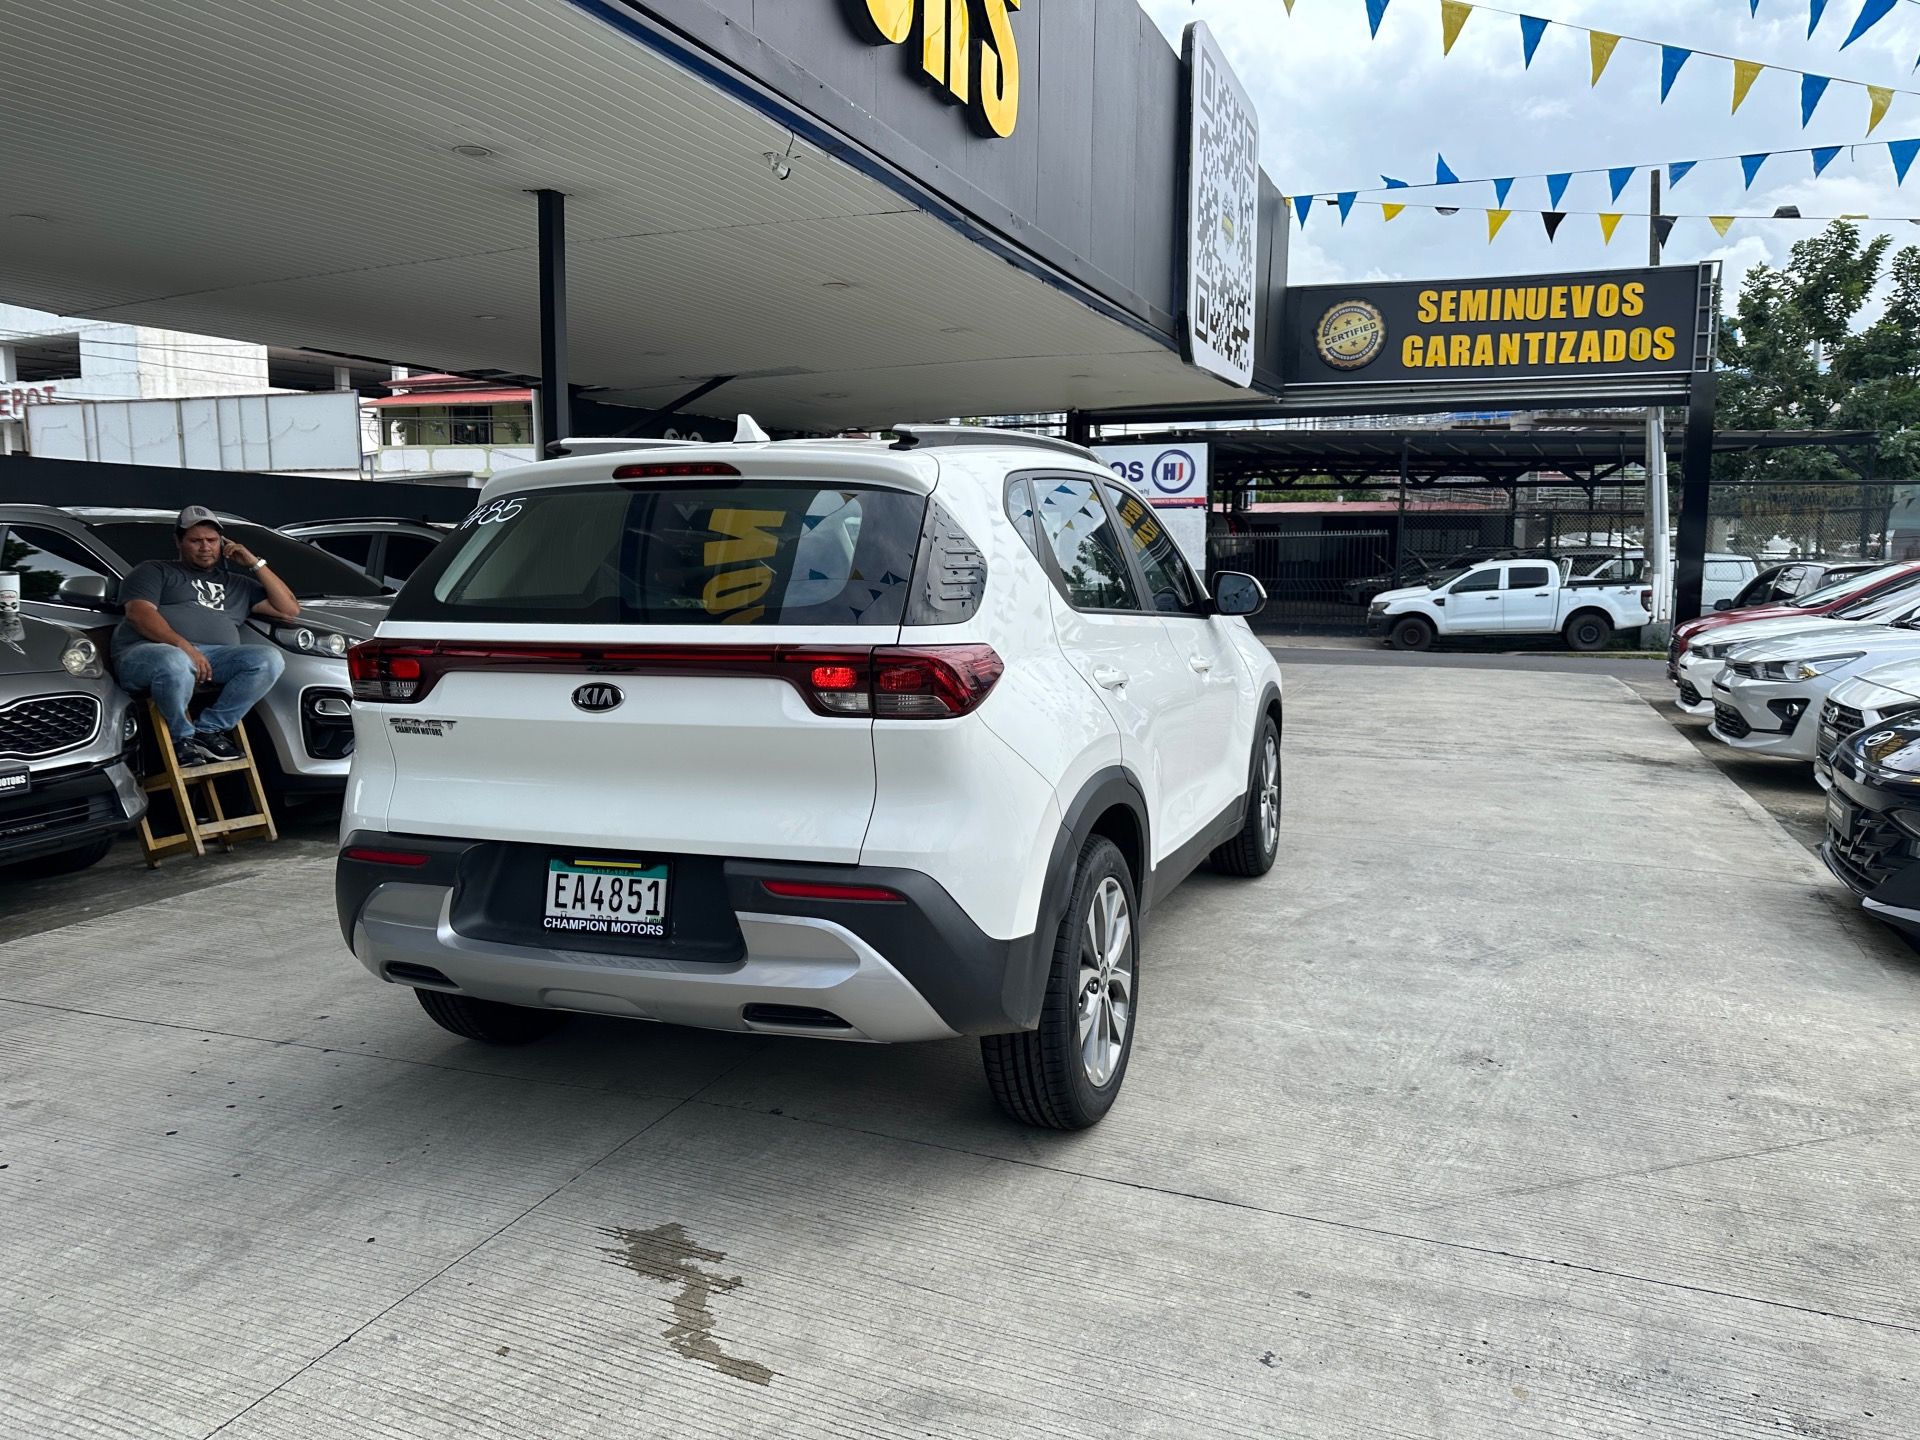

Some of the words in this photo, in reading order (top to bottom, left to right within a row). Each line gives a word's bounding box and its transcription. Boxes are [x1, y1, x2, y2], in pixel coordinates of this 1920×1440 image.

[1417, 282, 1645, 323] SEMINUEVOS
[1324, 322, 1377, 346] CERTIFIED
[1402, 326, 1676, 367] GARANTIZADOS
[459, 497, 528, 531] #85
[578, 687, 614, 706] KIA
[394, 725, 421, 735] CHAMPION
[421, 728, 443, 737] MOTORS
[554, 873, 661, 916] EA4851
[543, 917, 608, 932] CHAMPION
[611, 922, 664, 936] MOTORS
